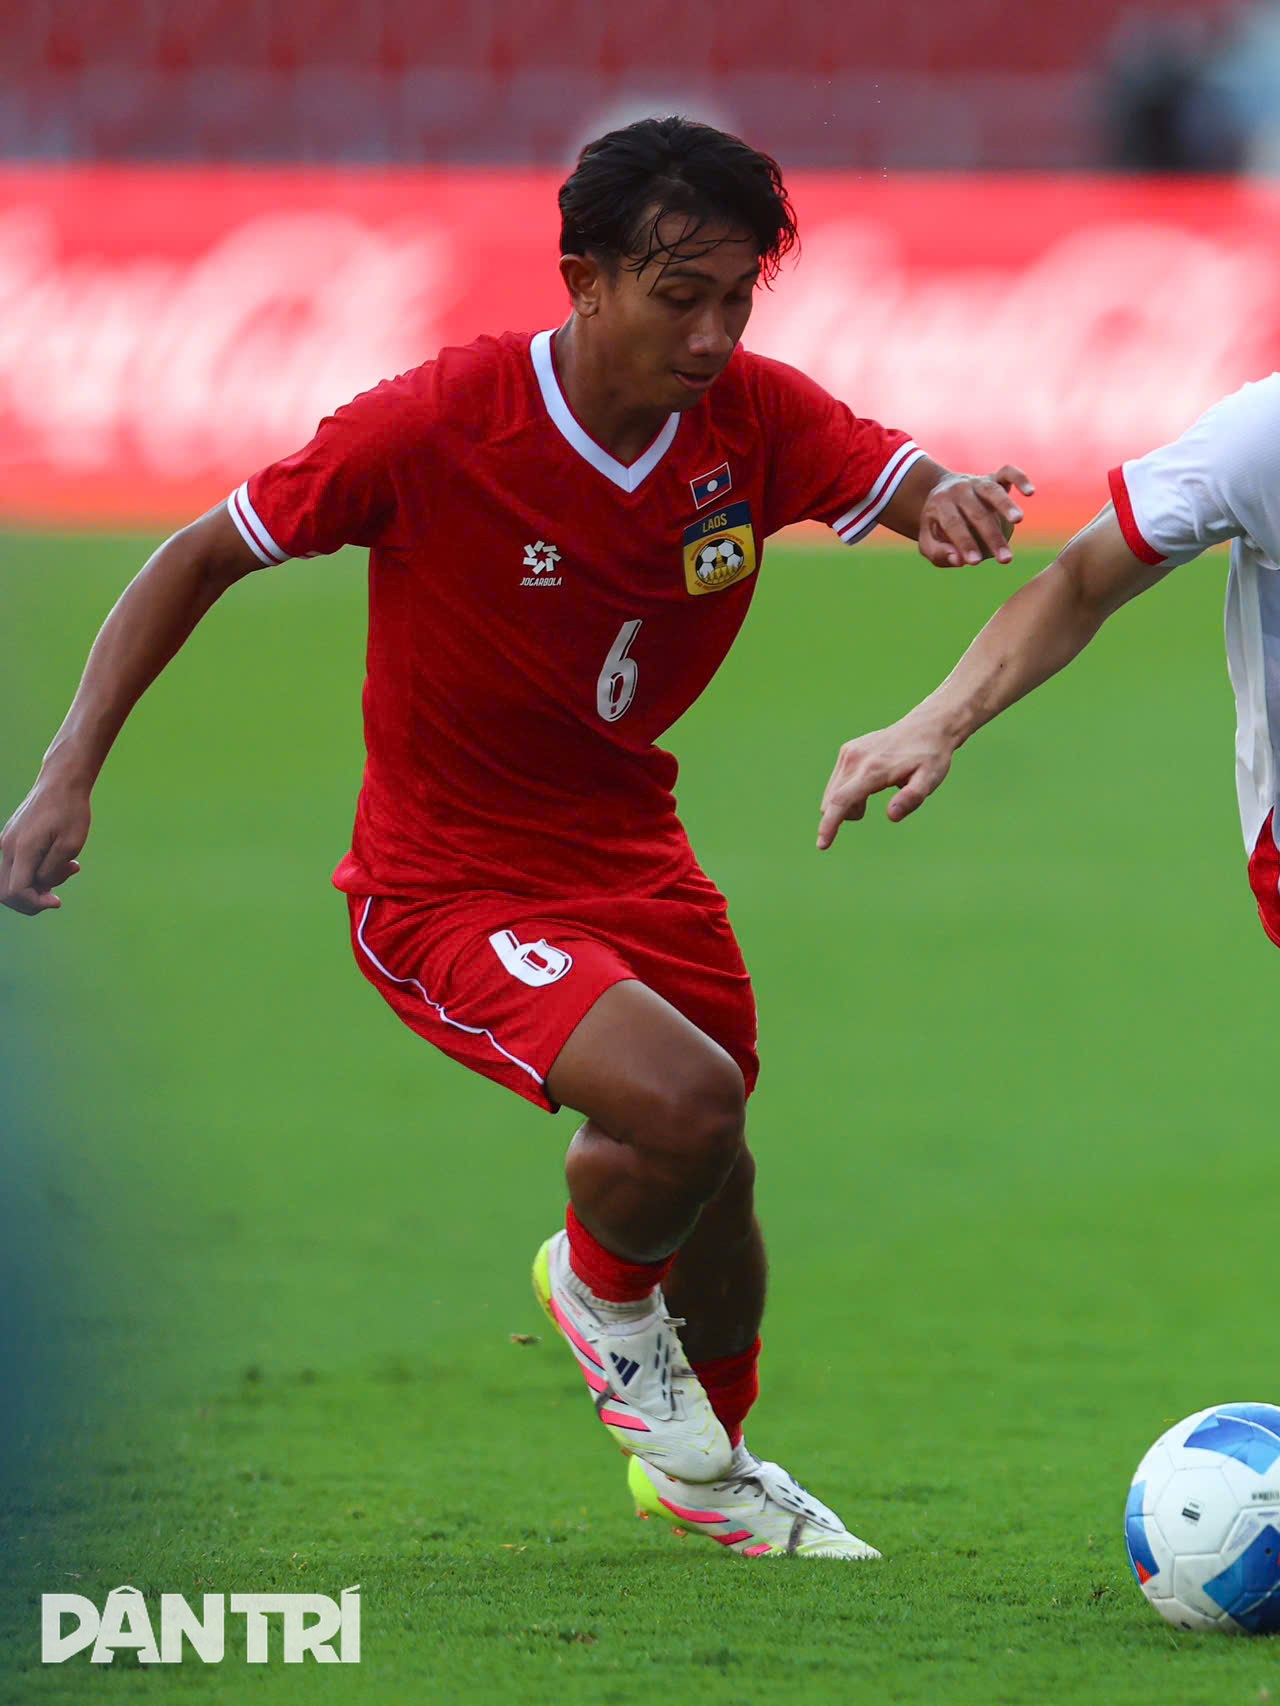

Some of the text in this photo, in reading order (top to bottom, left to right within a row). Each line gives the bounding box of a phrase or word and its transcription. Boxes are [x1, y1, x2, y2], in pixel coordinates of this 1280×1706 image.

[702, 512, 728, 533] LAOS
[520, 576, 563, 587] JOCARBOLA
[597, 618, 643, 722] 6
[488, 929, 574, 988] 6
